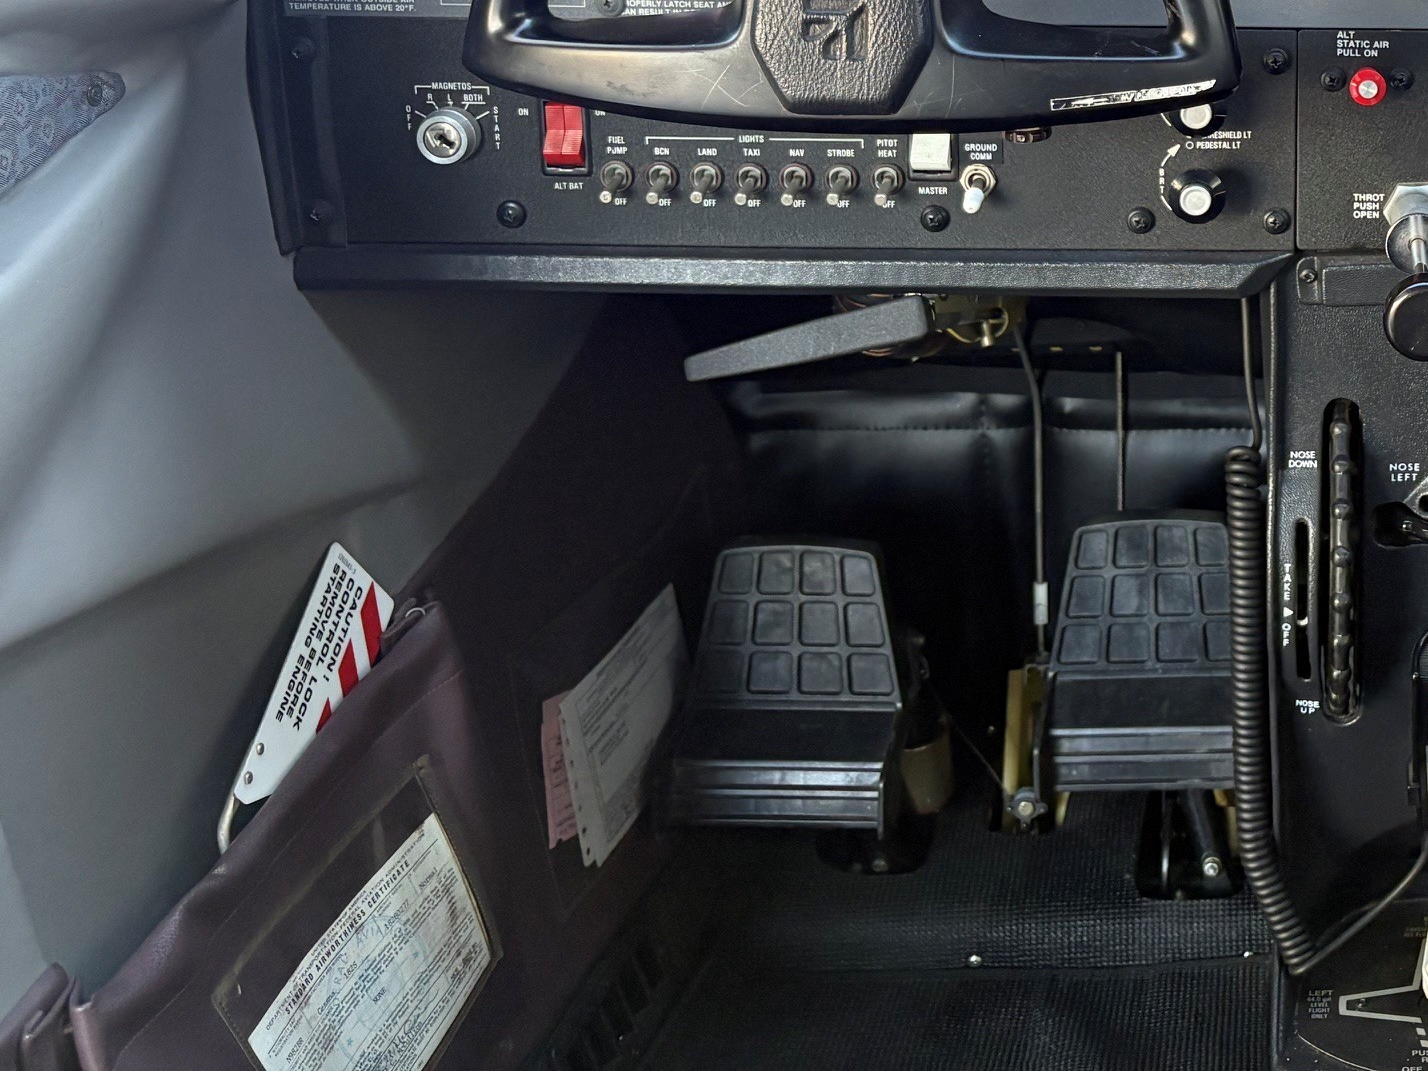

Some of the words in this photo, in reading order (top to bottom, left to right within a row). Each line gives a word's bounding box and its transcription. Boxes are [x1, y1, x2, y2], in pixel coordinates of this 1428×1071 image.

[1336, 31, 1355, 40] ALT
[1336, 39, 1370, 48] STATIC
[1372, 40, 1389, 49] AIR
[1336, 48, 1361, 57] PULL
[1363, 49, 1378, 57] ON
[431, 82, 471, 91] MAGNETOS
[698, 148, 717, 156] LAND
[964, 144, 998, 152] GROUND
[827, 149, 855, 157] STROBE
[970, 152, 992, 160] COMM
[554, 182, 567, 190] ALT
[569, 182, 583, 190] BAT
[918, 186, 948, 195] MASTER
[1353, 194, 1385, 202] THROT
[1353, 202, 1380, 210] PUSH
[1353, 210, 1380, 219] OPEN
[1389, 463, 1420, 472] NOSE
[1391, 472, 1418, 482] LEFT
[304, 562, 341, 648] STARTING
[315, 569, 347, 642] REMOVE
[316, 577, 355, 667] CONTROL
[326, 586, 363, 673] CAUTION
[275, 654, 305, 723] ENGINE
[285, 649, 317, 719] BEFORE
[293, 674, 318, 731] LOCK
[285, 972, 314, 1015] STANDARD
[315, 908, 366, 973] AIRWORTHINESS
[367, 860, 411, 910] CERTIFICATE
